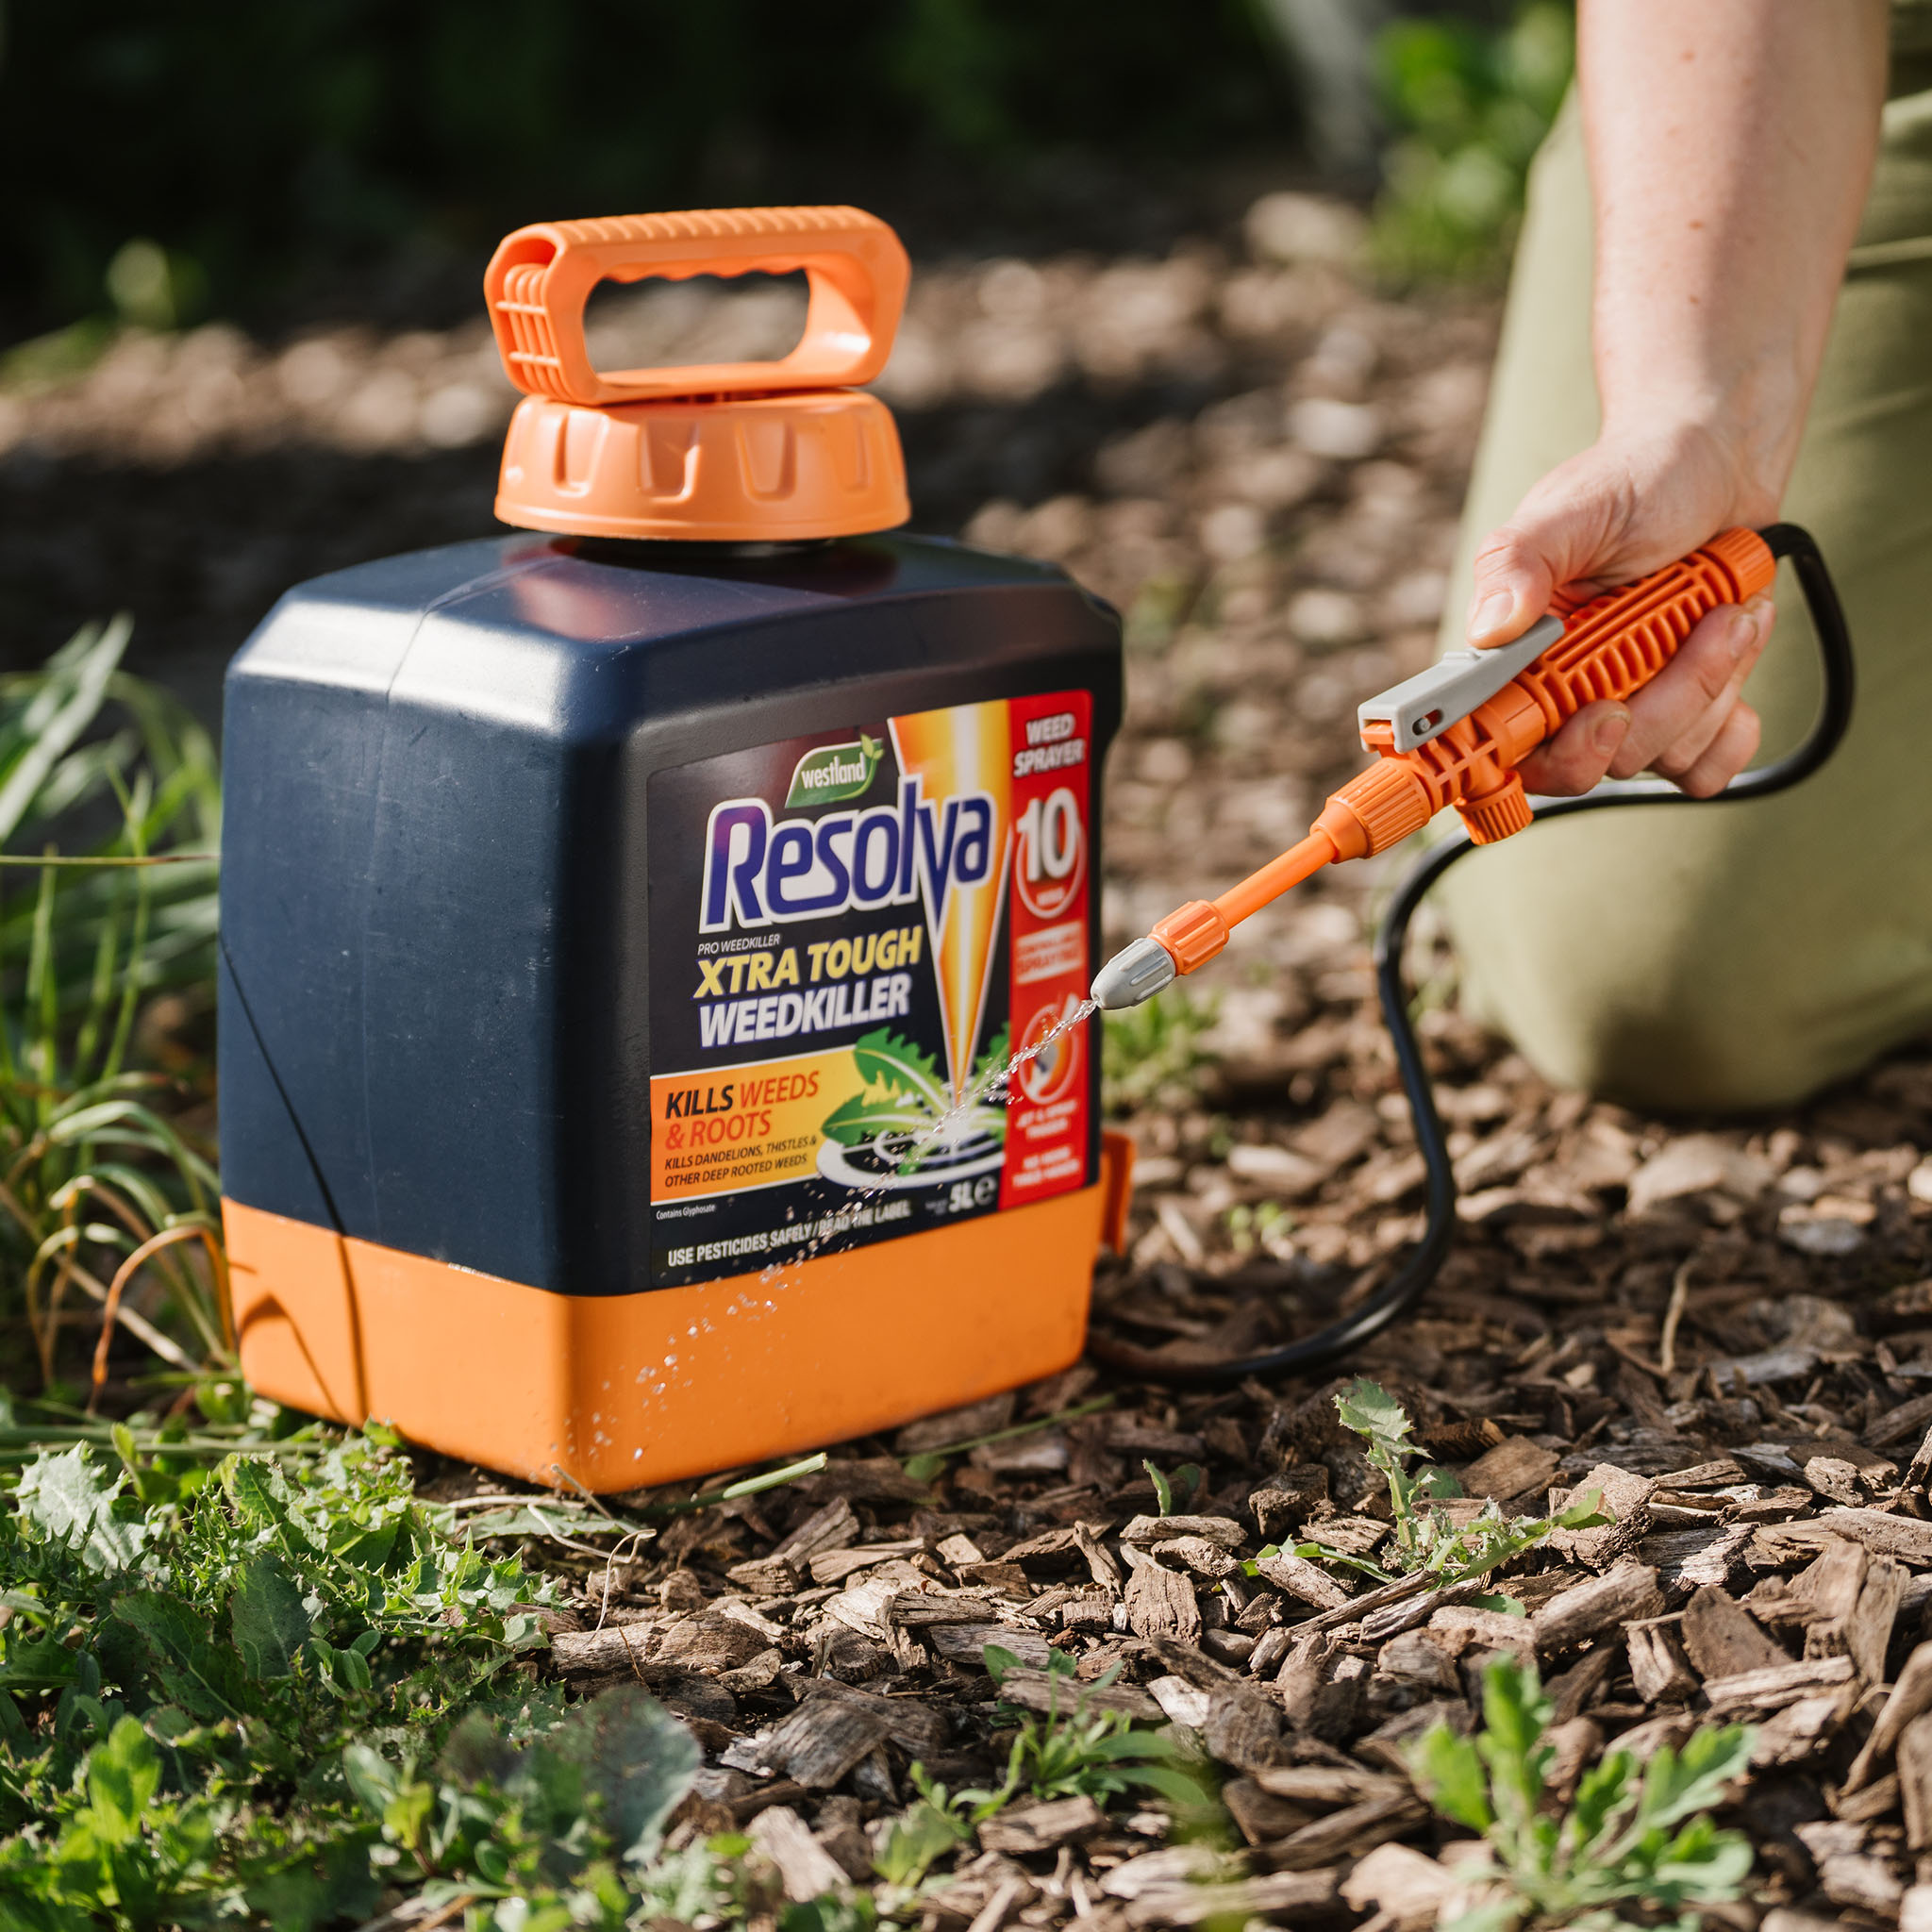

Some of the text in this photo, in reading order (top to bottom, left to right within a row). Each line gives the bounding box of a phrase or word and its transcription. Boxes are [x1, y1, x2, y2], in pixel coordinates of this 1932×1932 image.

[1026, 712, 1075, 745] WEED
[801, 754, 866, 791] westland
[1013, 739, 1085, 779] SPRAYER
[699, 773, 996, 934] Resolva
[1016, 787, 1079, 883] 10
[694, 925, 923, 998] XTRA TOUGH
[698, 933, 780, 957] PRO WEEDKILLER
[700, 974, 912, 1049] WEEDKILLER
[665, 1070, 819, 1120] KILLS WEEDS
[665, 1109, 772, 1151] & ROOTS
[665, 1135, 817, 1171] KILLS DANDELIONS, THISTLES &
[665, 1153, 808, 1188] OTHER DEEP ROOTED WEEDS
[656, 1203, 716, 1221] Contains Glyphosate
[668, 1247, 694, 1268] USE
[696, 1234, 769, 1262] PESTICIDES
[874, 1199, 911, 1224] LABEL
